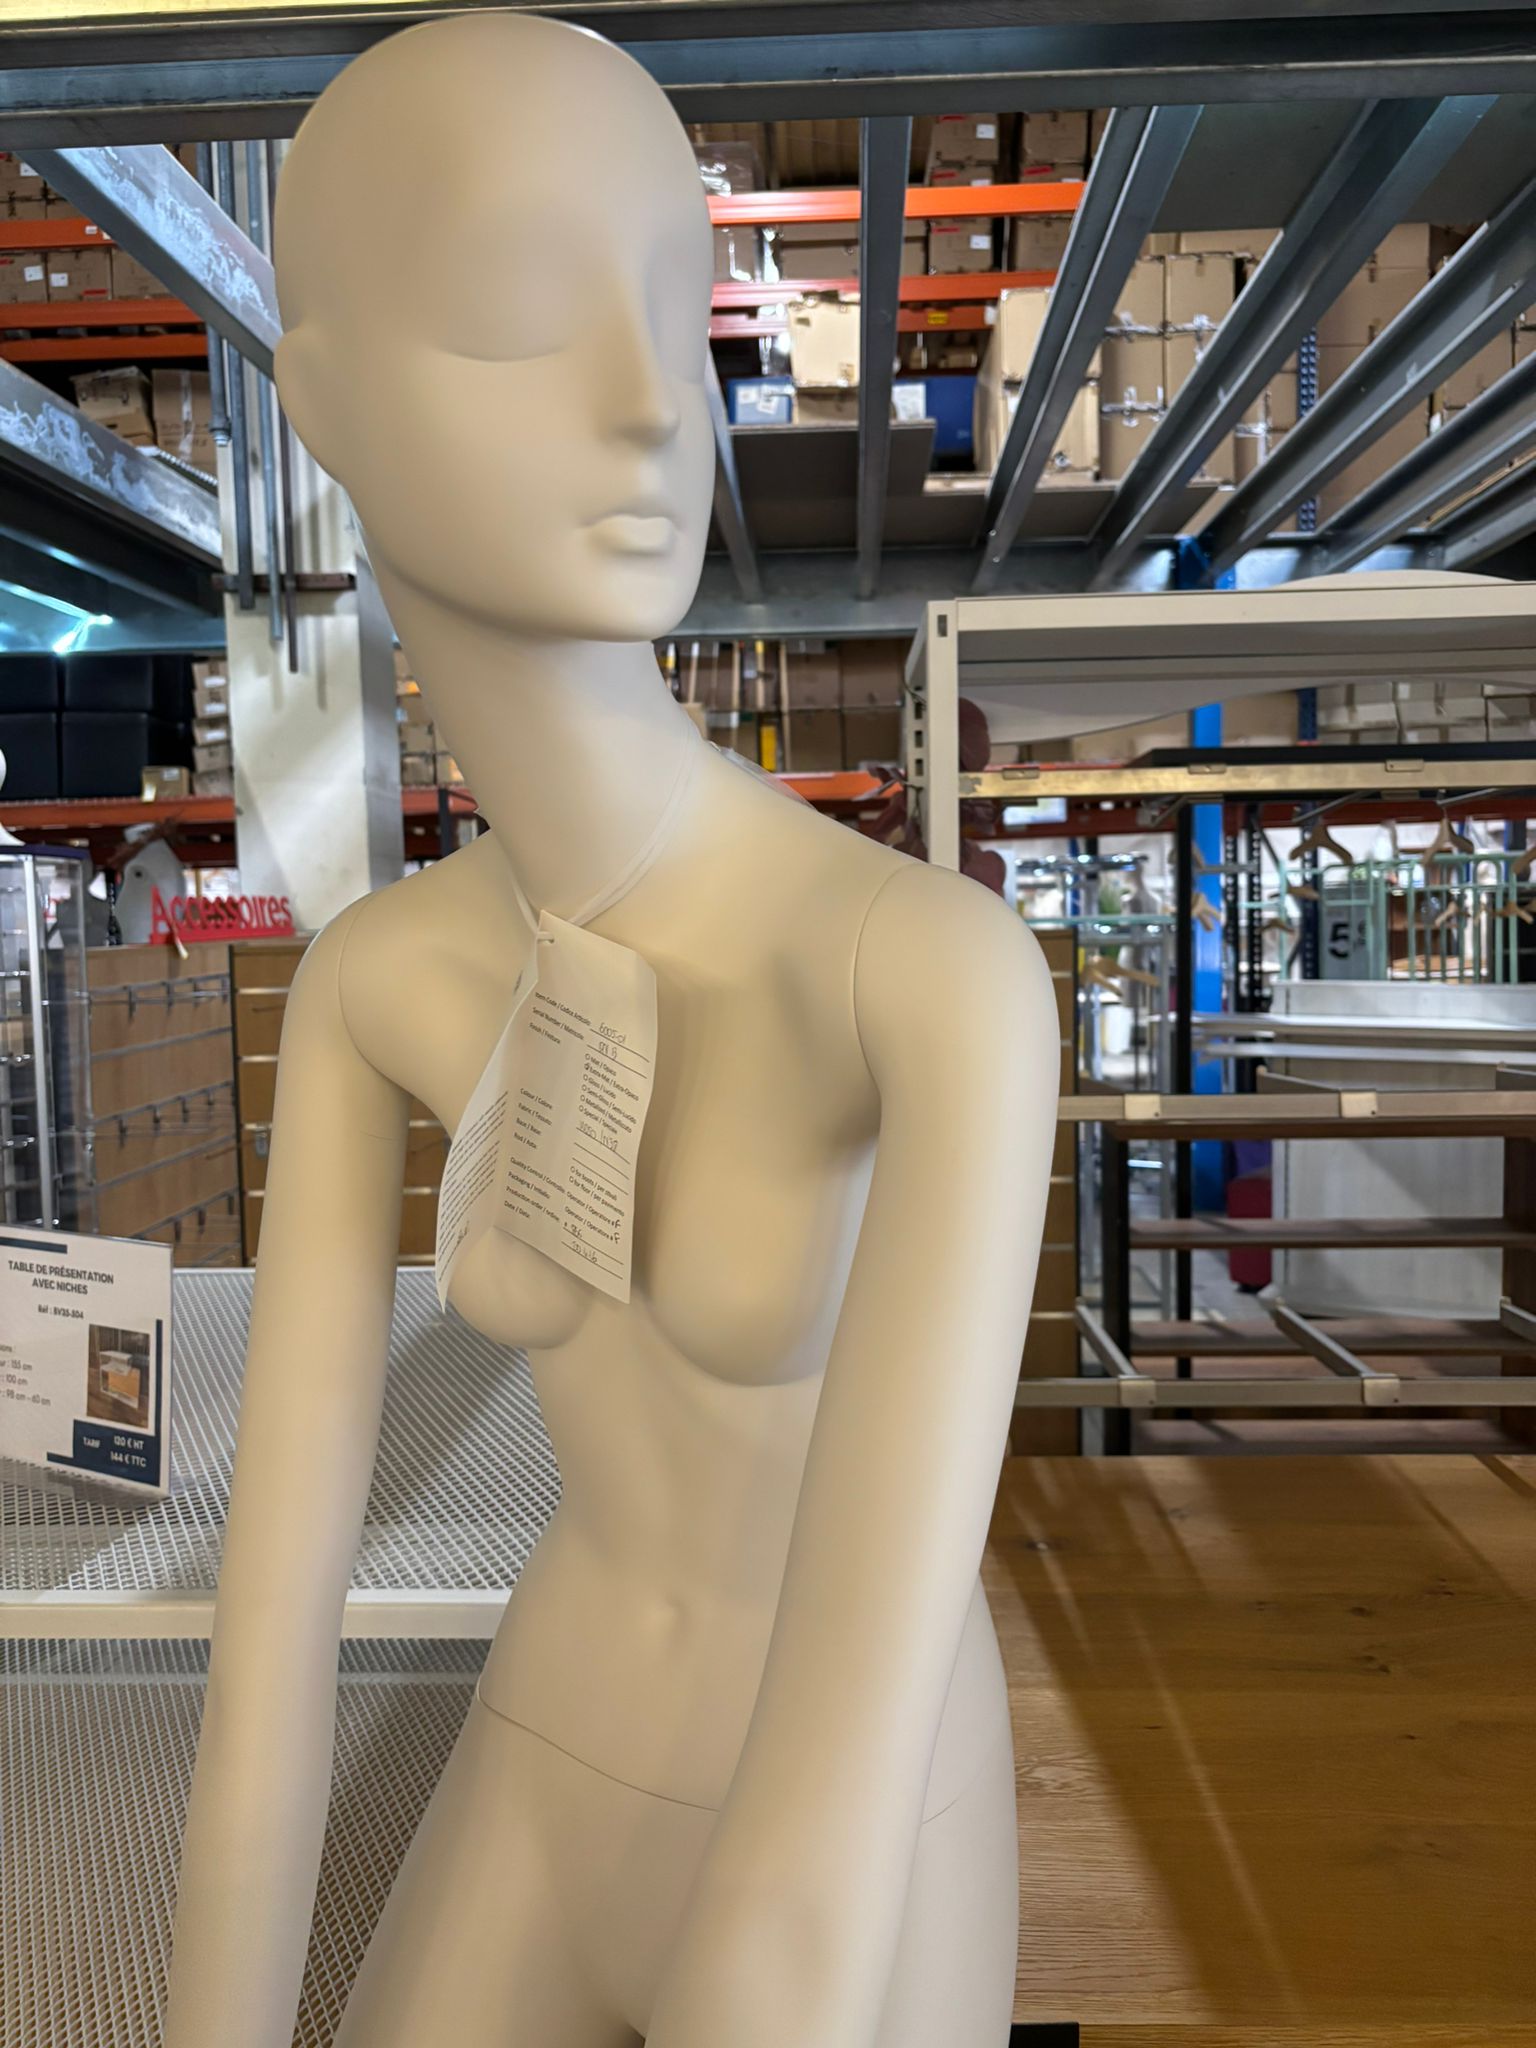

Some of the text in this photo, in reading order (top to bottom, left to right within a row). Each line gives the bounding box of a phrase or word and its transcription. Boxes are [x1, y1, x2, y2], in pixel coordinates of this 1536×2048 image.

[151, 884, 292, 934] Accessoires
[511, 1157, 526, 1171] Quality
[527, 1166, 543, 1179] Control
[508, 1171, 530, 1189] Packaging
[506, 1186, 530, 1202] Production
[504, 1201, 515, 1211] Date
[519, 1208, 530, 1219] Data
[8, 1260, 114, 1284] TABLE DE PRÉSENTATION
[32, 1278, 88, 1295] AVEC NICHES
[23, 1363, 33, 1371] cm
[17, 1378, 28, 1387] cm
[16, 1393, 26, 1401] cm
[134, 1439, 145, 1450] HT
[110, 1451, 123, 1462] 144
[131, 1455, 147, 1468] TTC
